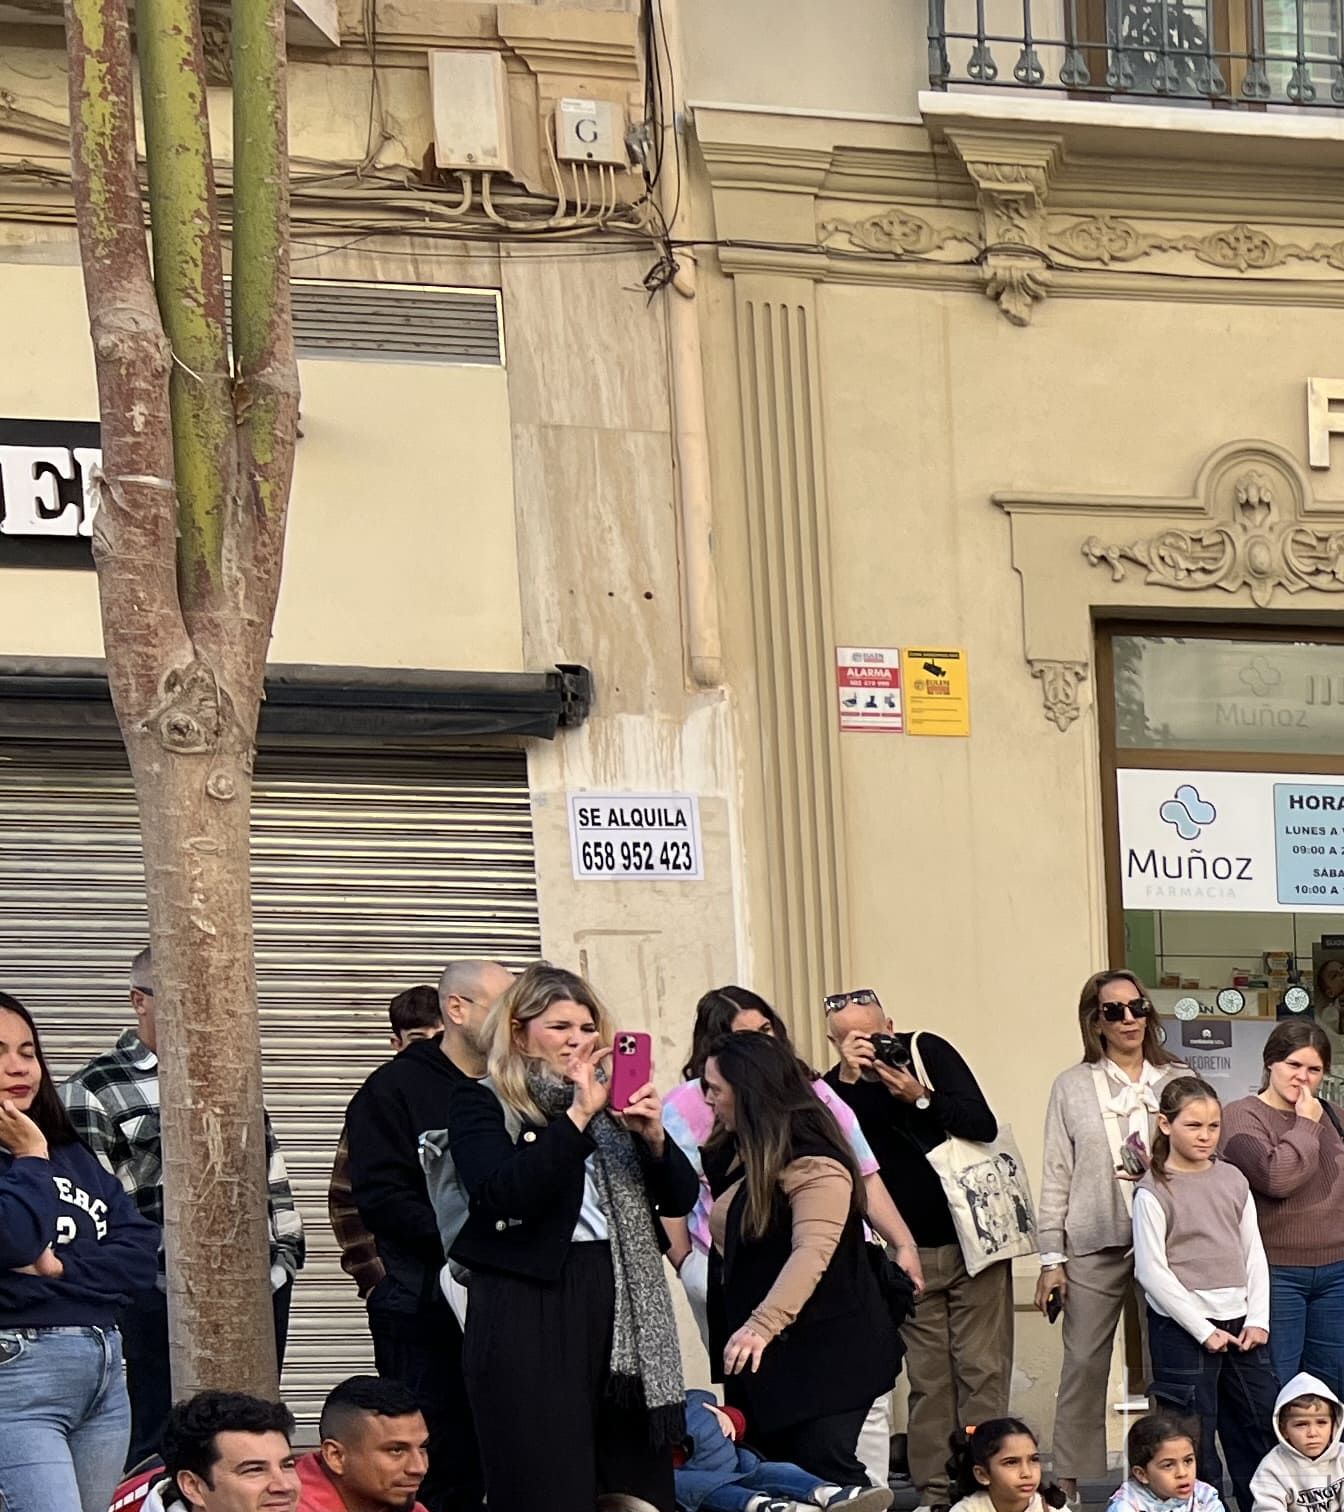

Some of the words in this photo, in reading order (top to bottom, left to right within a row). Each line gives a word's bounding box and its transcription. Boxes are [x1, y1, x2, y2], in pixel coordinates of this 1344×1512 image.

[847, 668, 892, 678] ALARMA
[579, 808, 601, 827] SE
[608, 808, 687, 828] ALQUILA
[1285, 826, 1327, 836] LUNES
[1330, 827, 1339, 836] A
[582, 841, 615, 870] 658
[621, 841, 654, 870] 952
[660, 841, 692, 871] 423
[1292, 845, 1325, 856] 09:00
[1329, 846, 1338, 856] A
[1128, 849, 1253, 881] Muñoz
[1145, 886, 1237, 899] FARMACIA
[1295, 885, 1326, 895] 10:00
[1330, 886, 1339, 895] A
